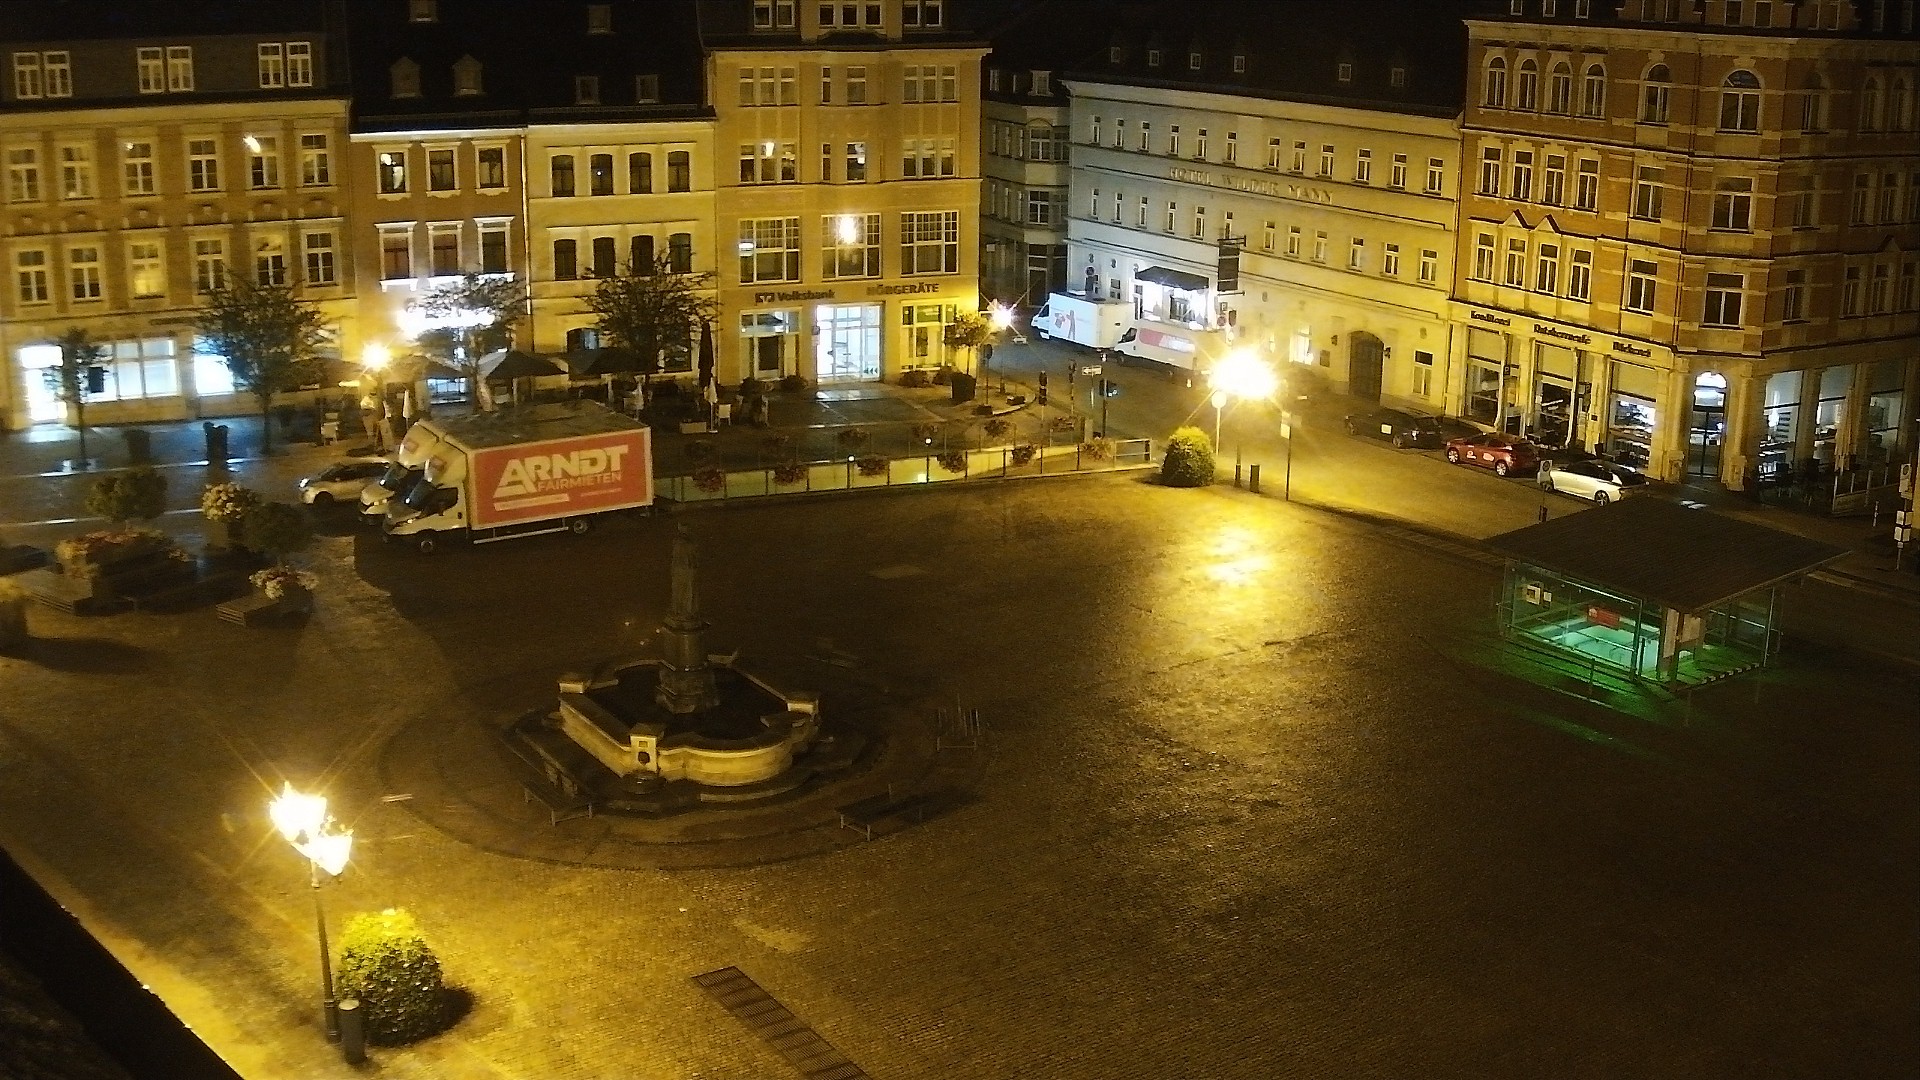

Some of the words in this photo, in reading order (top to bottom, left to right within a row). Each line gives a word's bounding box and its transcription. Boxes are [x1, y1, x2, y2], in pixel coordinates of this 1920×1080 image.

[1169, 167, 1213, 186] HOTEL
[1288, 184, 1333, 205] MANN
[777, 289, 836, 302] Volksbank
[866, 282, 940, 296] HÖRGERÄTE
[493, 445, 629, 499] ARNDT
[537, 472, 622, 492] FAIRMIETEN
